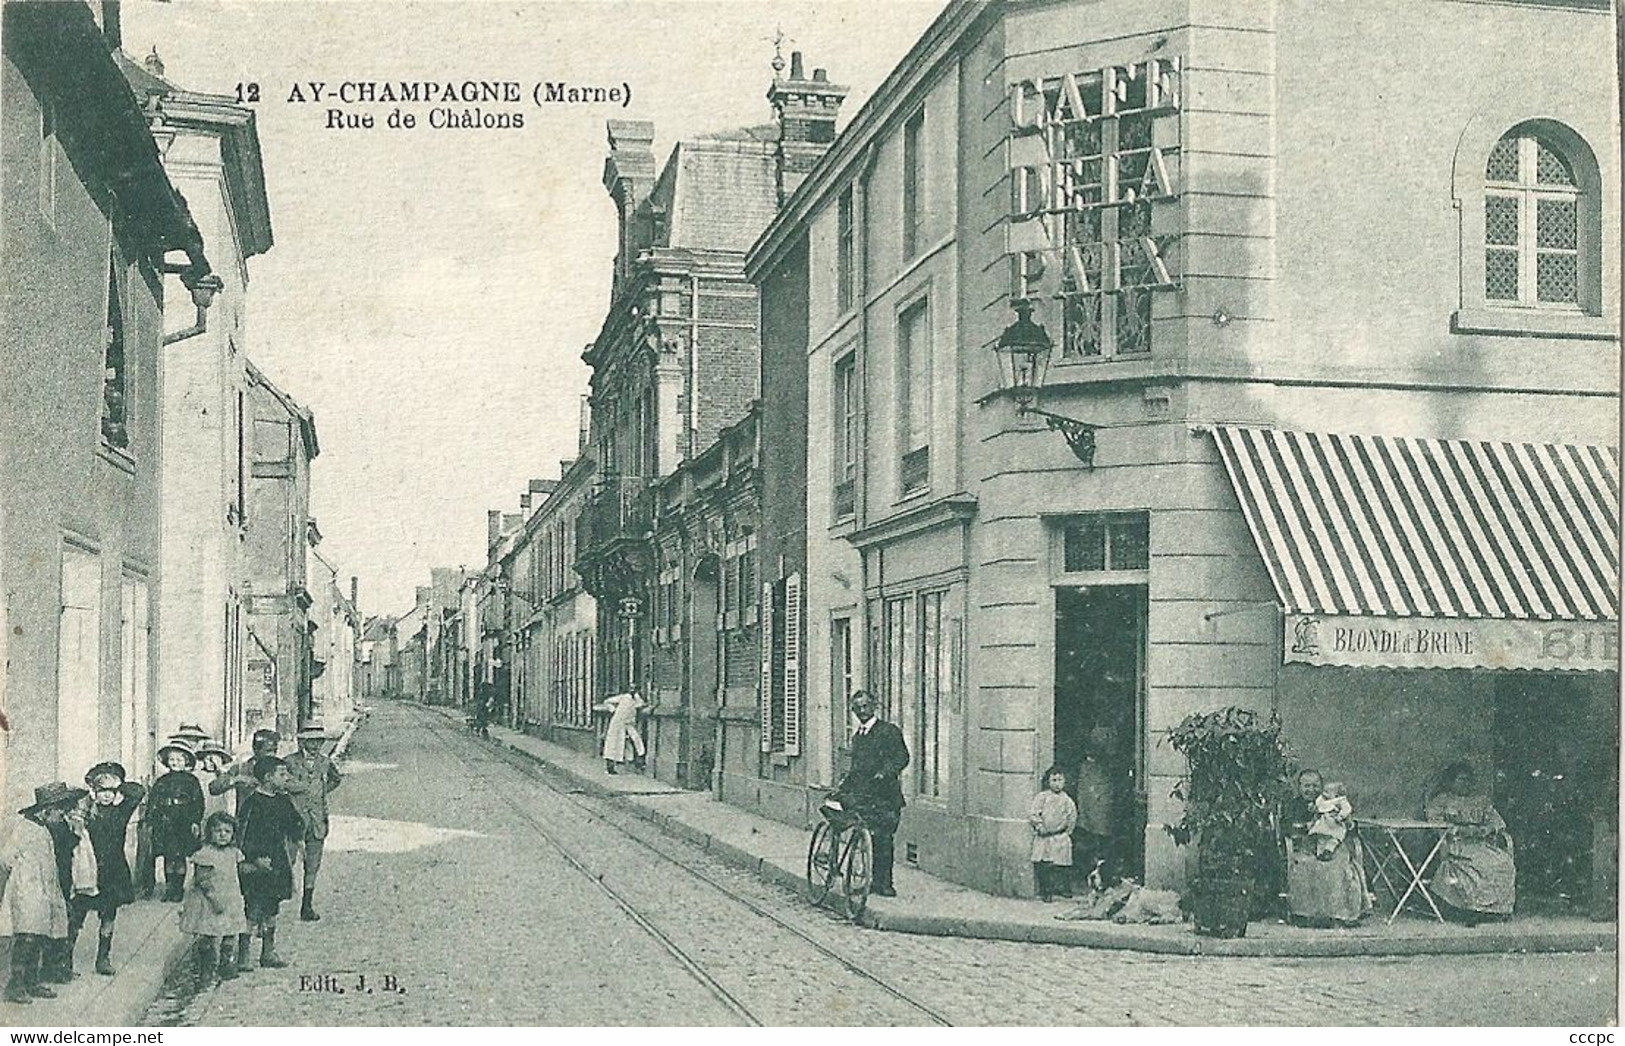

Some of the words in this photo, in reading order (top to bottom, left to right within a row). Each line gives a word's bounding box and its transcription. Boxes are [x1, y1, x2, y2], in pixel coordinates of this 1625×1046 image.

[1010, 158, 1084, 223] DE
[1101, 146, 1177, 207] LA
[1332, 627, 1402, 655] BLONDE
[1414, 628, 1474, 656] BRUNE
